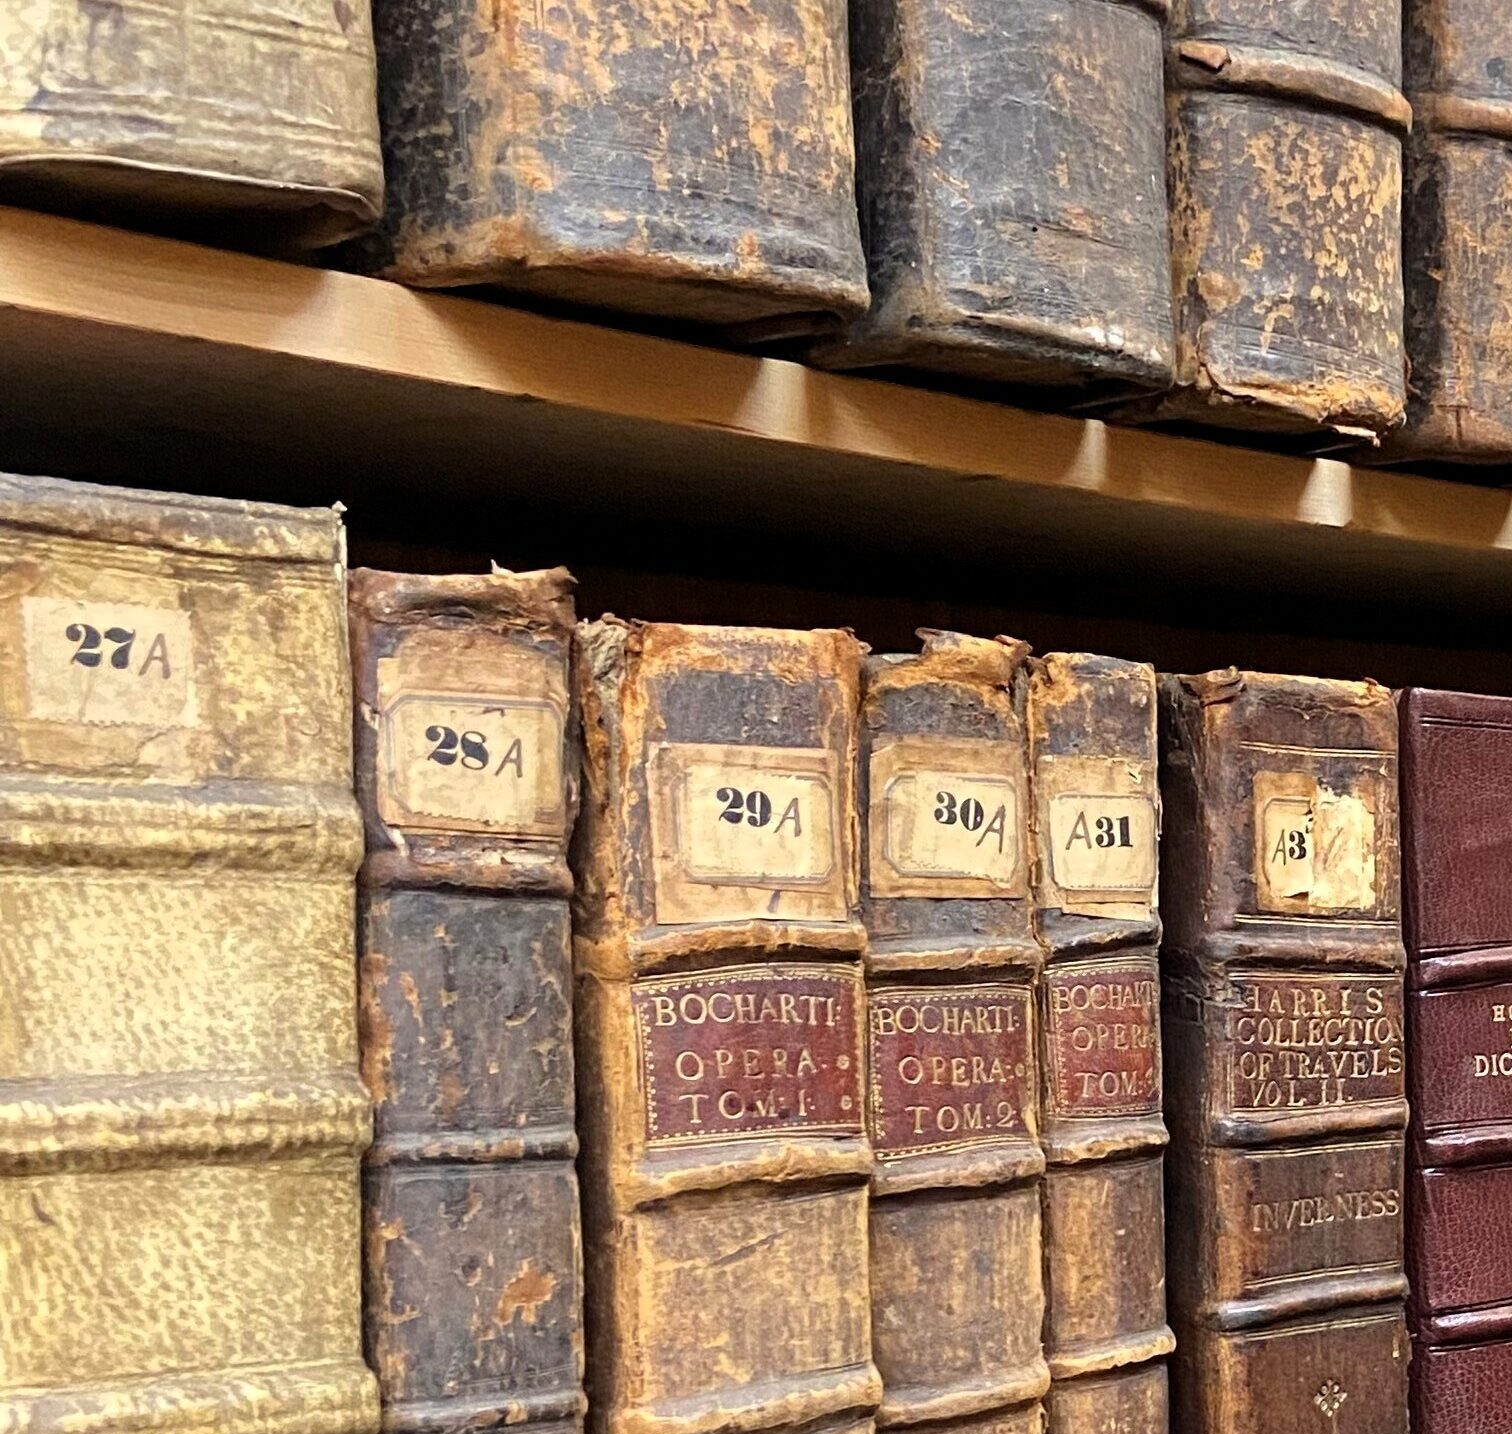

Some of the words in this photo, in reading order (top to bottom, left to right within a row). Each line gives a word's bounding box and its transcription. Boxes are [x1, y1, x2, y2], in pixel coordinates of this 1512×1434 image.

[1240, 1050, 1273, 1081] OF
[1278, 1046, 1402, 1079] TRAVELS
[1251, 1188, 1400, 1233] INVERNESS
